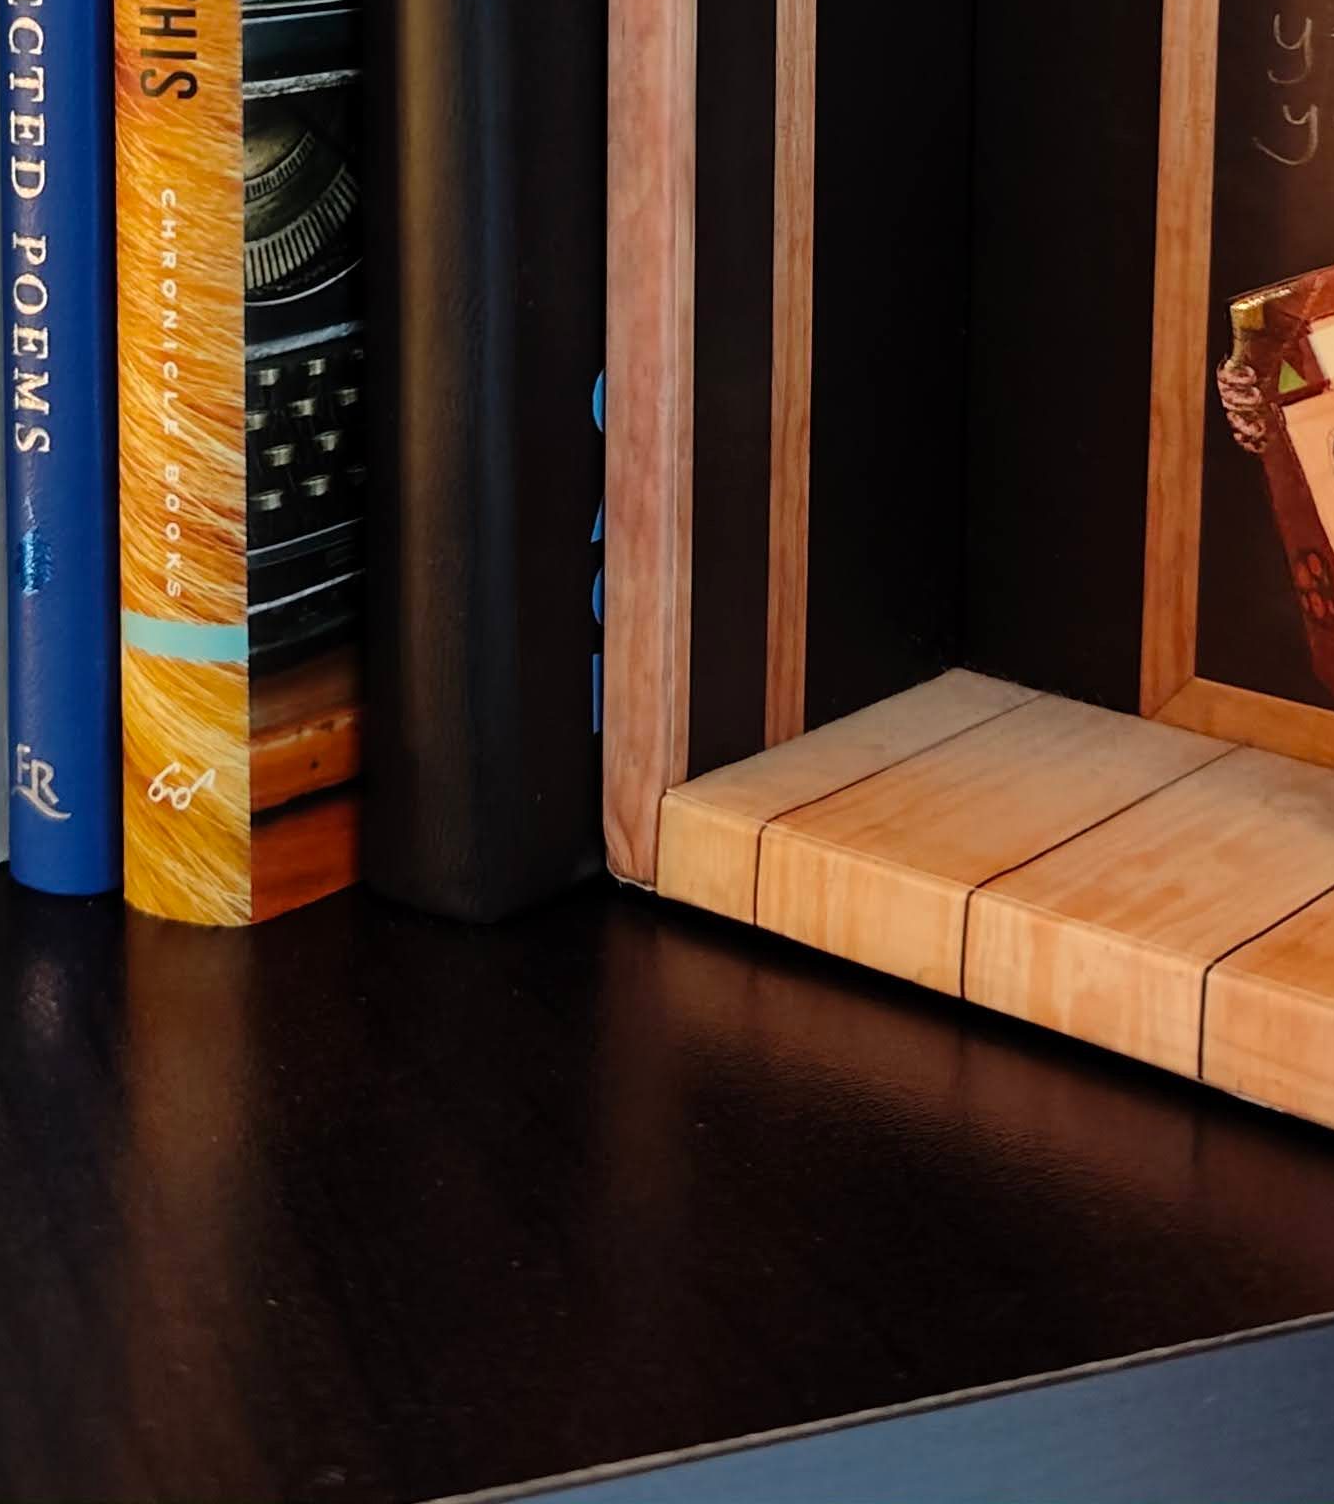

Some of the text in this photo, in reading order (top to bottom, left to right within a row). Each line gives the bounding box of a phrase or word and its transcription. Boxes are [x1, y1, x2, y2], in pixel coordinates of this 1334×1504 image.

[13, 234, 49, 452] POEMS
[160, 188, 182, 597] CHRONICLE BOOKS
